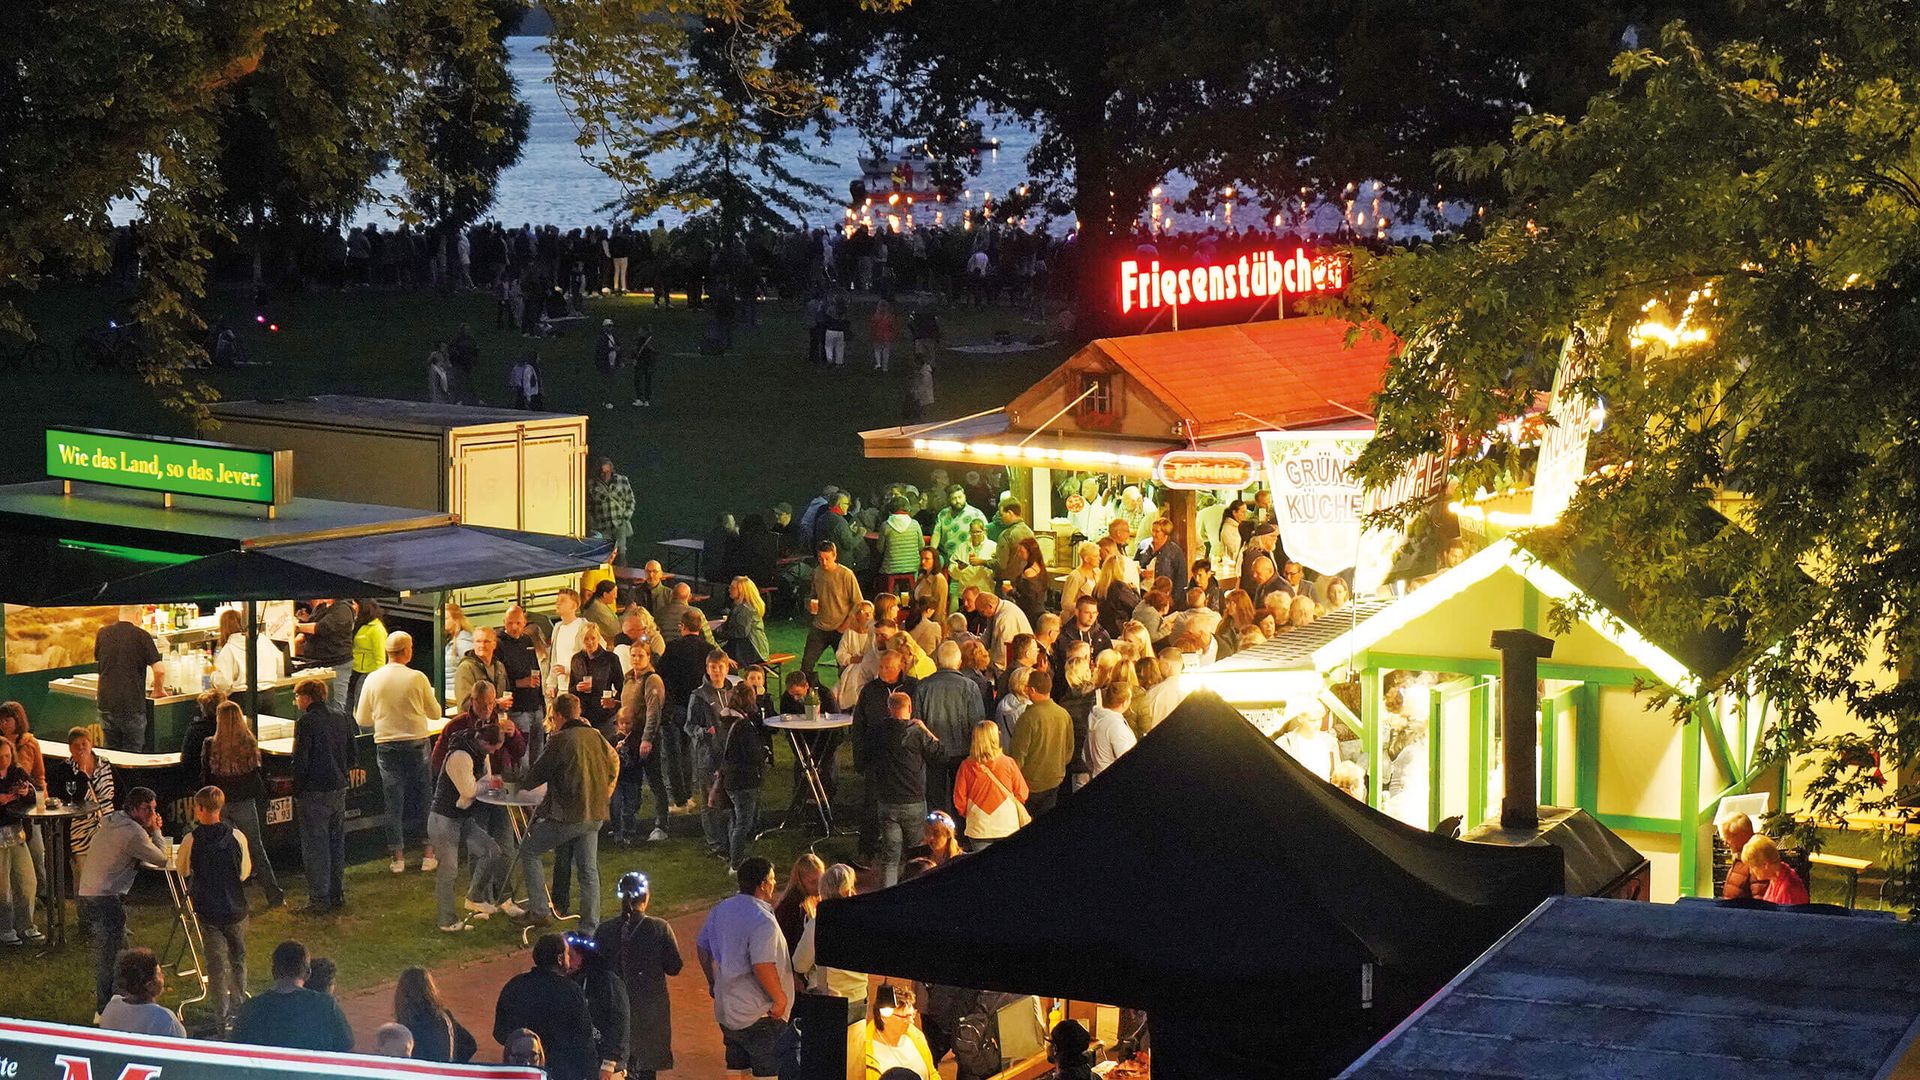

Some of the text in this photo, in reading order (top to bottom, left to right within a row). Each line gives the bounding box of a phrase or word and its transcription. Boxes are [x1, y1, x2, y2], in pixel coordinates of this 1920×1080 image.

[1121, 248, 1342, 314] Friesenstübchen
[58, 443, 262, 487] Wie das Land, so das Jever.
[1286, 488, 1363, 524] KÜCHE
